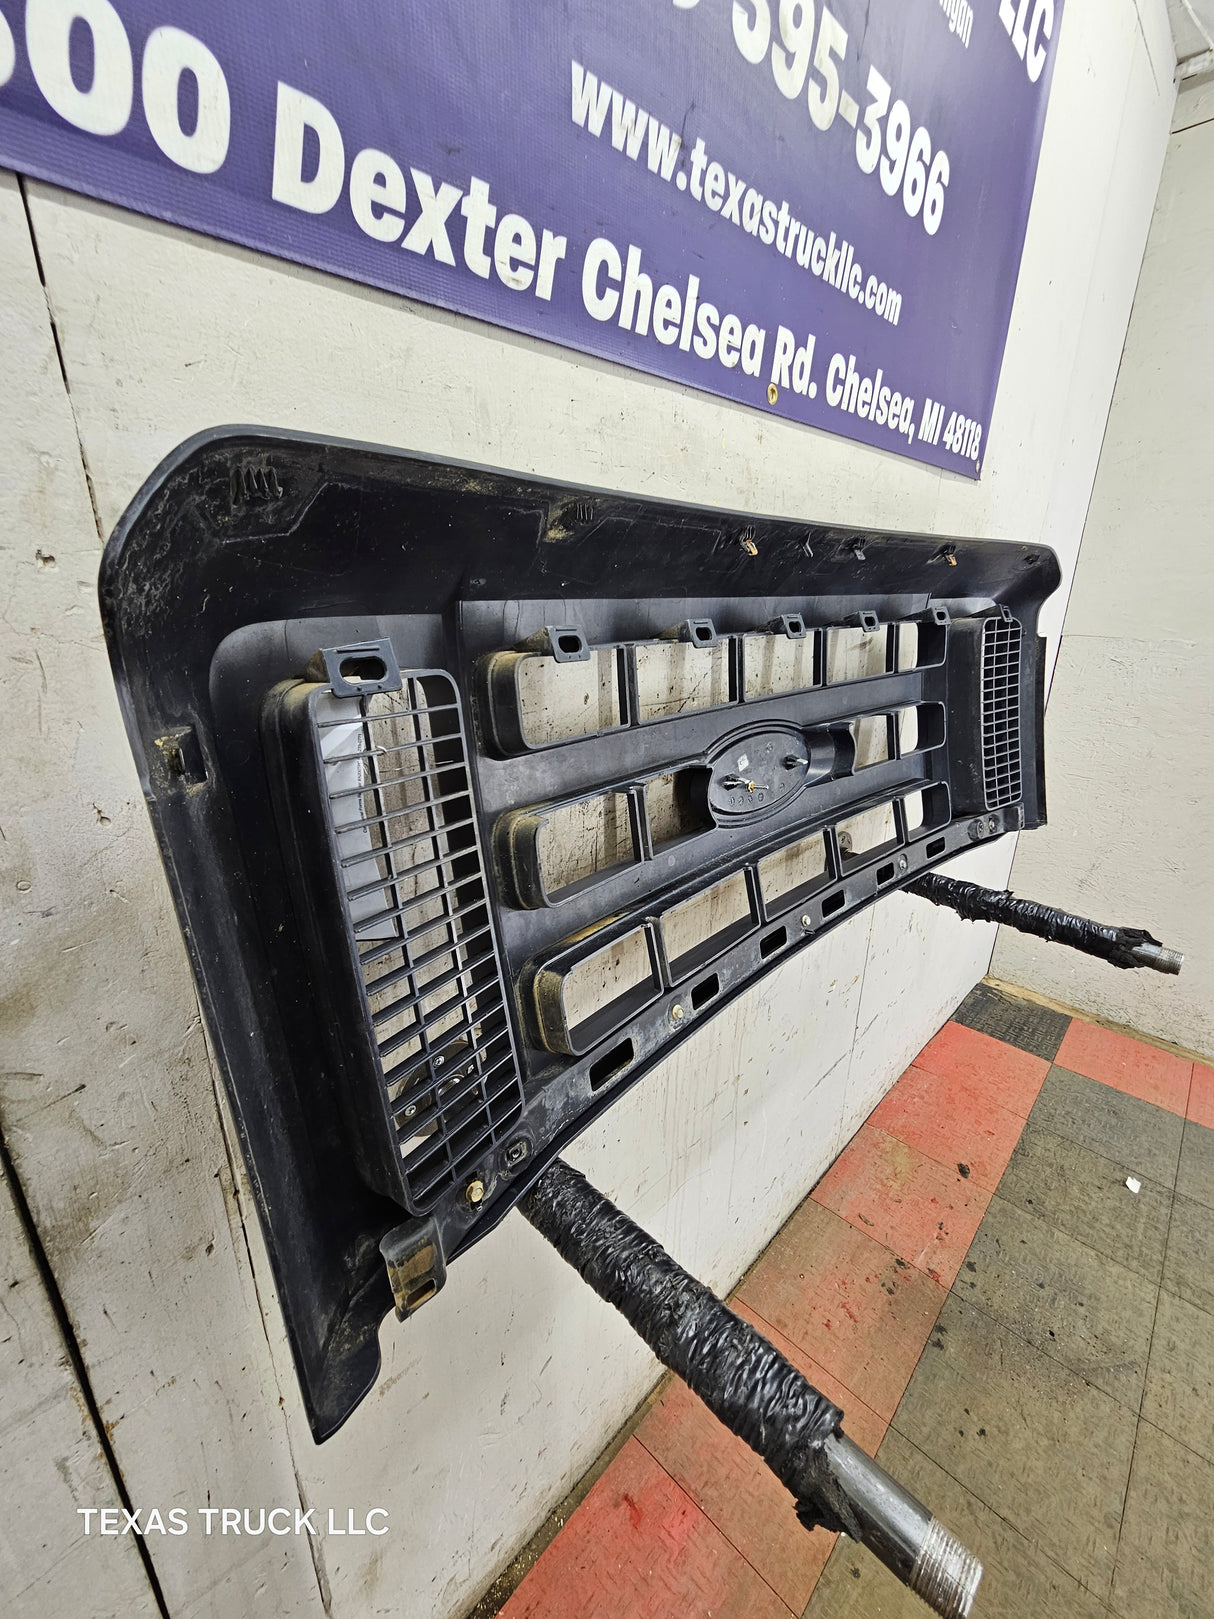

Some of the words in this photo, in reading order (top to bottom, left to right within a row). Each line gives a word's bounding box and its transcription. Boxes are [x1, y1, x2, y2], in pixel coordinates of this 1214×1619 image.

[0, 0, 231, 174] 00
[272, 81, 567, 301] Dexter
[582, 237, 766, 379] Chelsea
[770, 325, 818, 399] Rd.
[825, 353, 915, 445] Chelsea,
[917, 397, 946, 446] MI
[942, 411, 982, 461] 48118
[571, 60, 903, 326] www.texastruckllc.com
